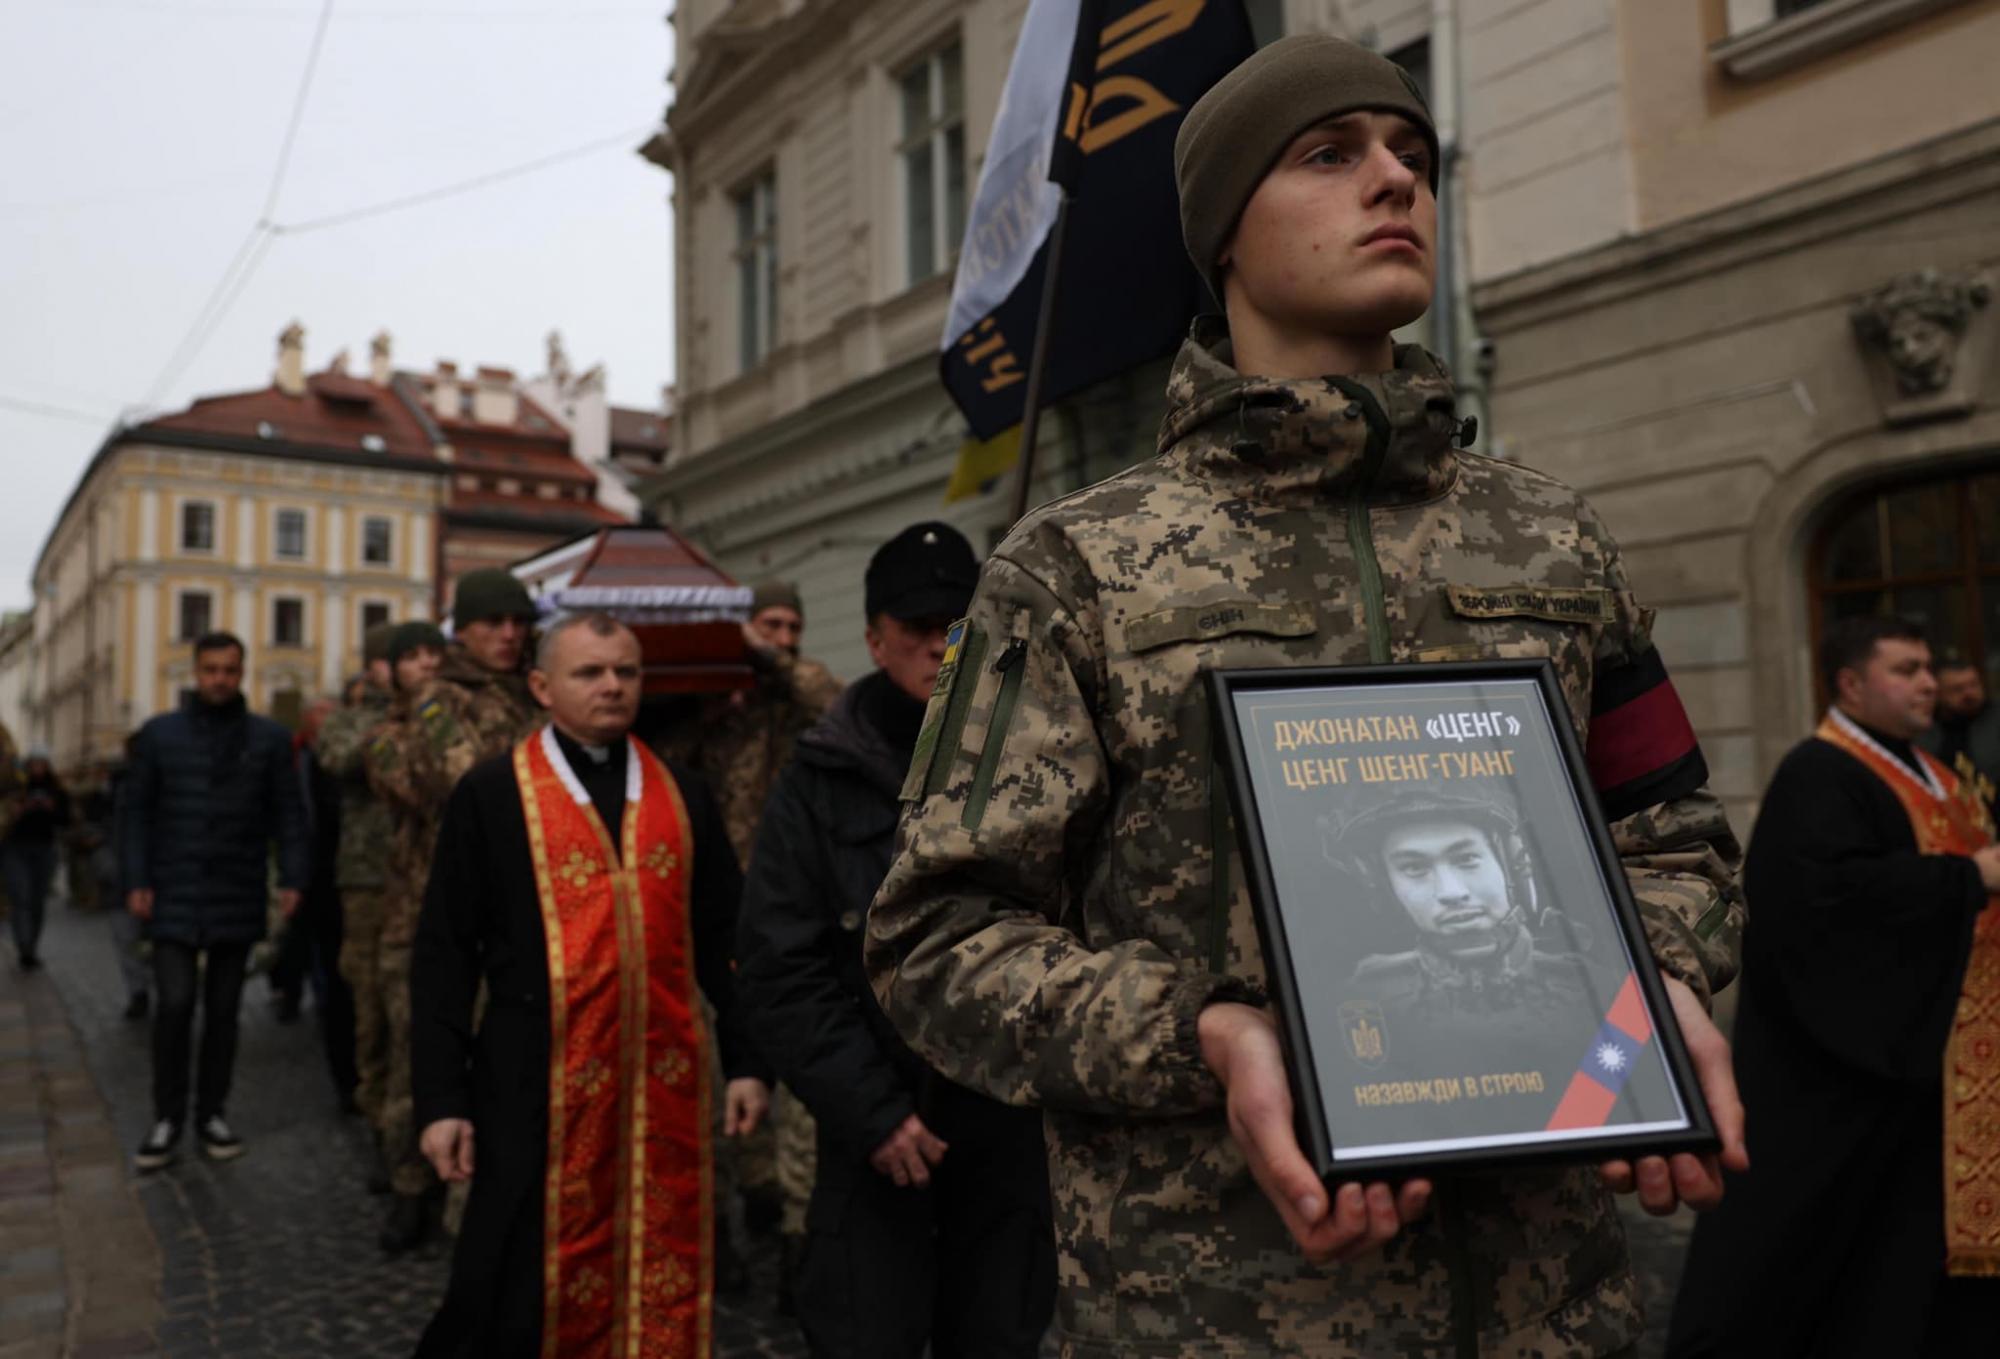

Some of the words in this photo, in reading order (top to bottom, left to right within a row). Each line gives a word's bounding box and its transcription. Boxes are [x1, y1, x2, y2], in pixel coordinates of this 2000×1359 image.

[1274, 715, 1420, 750] ДЖОНАТАН
[1426, 711, 1521, 742] «ЦЕНГ»
[1282, 757, 1349, 790] ЦЕНГ
[1357, 750, 1515, 783] ШЕНГ-ГУАНГ
[1464, 1076, 1479, 1098] В
[1481, 1071, 1545, 1097] СТРОЮ
